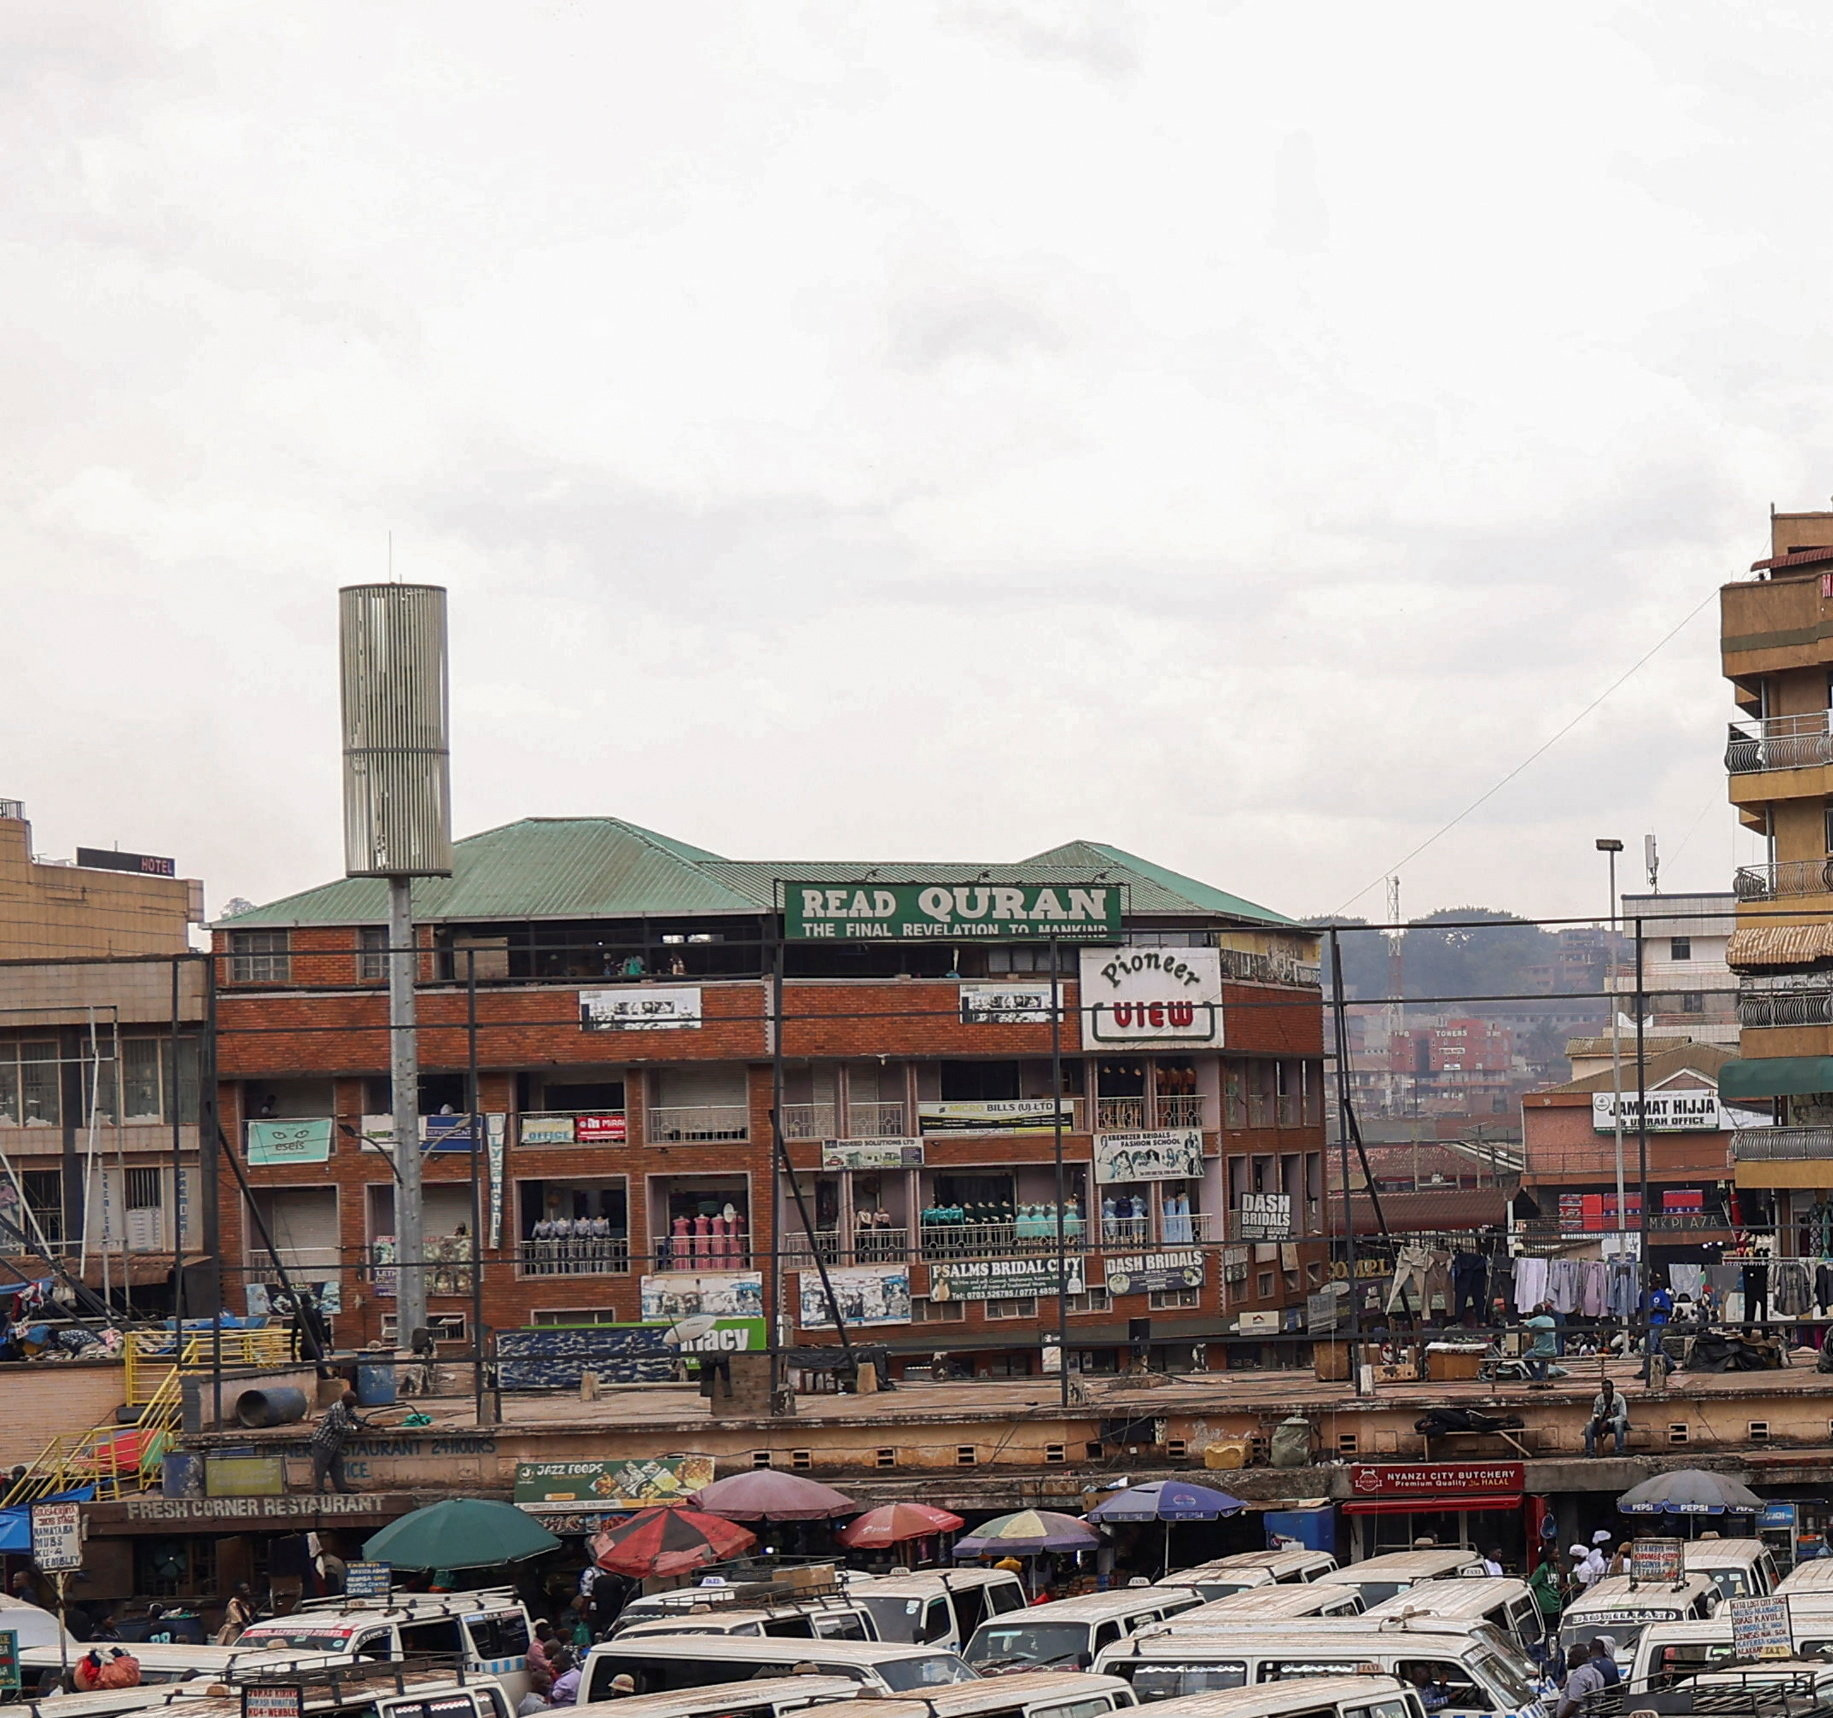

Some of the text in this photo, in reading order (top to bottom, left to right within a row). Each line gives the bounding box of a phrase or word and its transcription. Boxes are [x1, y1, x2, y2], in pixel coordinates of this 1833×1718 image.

[141, 856, 171, 873] HOTEL
[801, 885, 1108, 922] READ QURAN
[803, 923, 840, 938] THE
[846, 923, 894, 938] FINAL
[902, 923, 1004, 937] REVELATION
[1101, 951, 1200, 988] Pioneer
[986, 1103, 1015, 1113] BILLS
[1033, 1101, 1053, 1111] LTD
[1673, 1099, 1715, 1115] HIJJA
[1121, 1138, 1181, 1147] FASHION SCHOOL
[1242, 1193, 1291, 1212] DASH
[1242, 1213, 1291, 1226] BRIDALS
[932, 1261, 990, 1279] PSALMS
[991, 1259, 1037, 1276] BRIDAL
[1107, 1250, 1203, 1274] DASH BRIDALS
[537, 1463, 603, 1476] JAZZ FOODS
[1387, 1469, 1515, 1482] NYANZI CITY BUTCHERY
[1395, 1480, 1467, 1488] Premium Quality
[1481, 1478, 1509, 1487] HALAL
[127, 1495, 385, 1520] FRESH CORNER RESTAURANT
[1680, 1504, 1709, 1512] PEPSI
